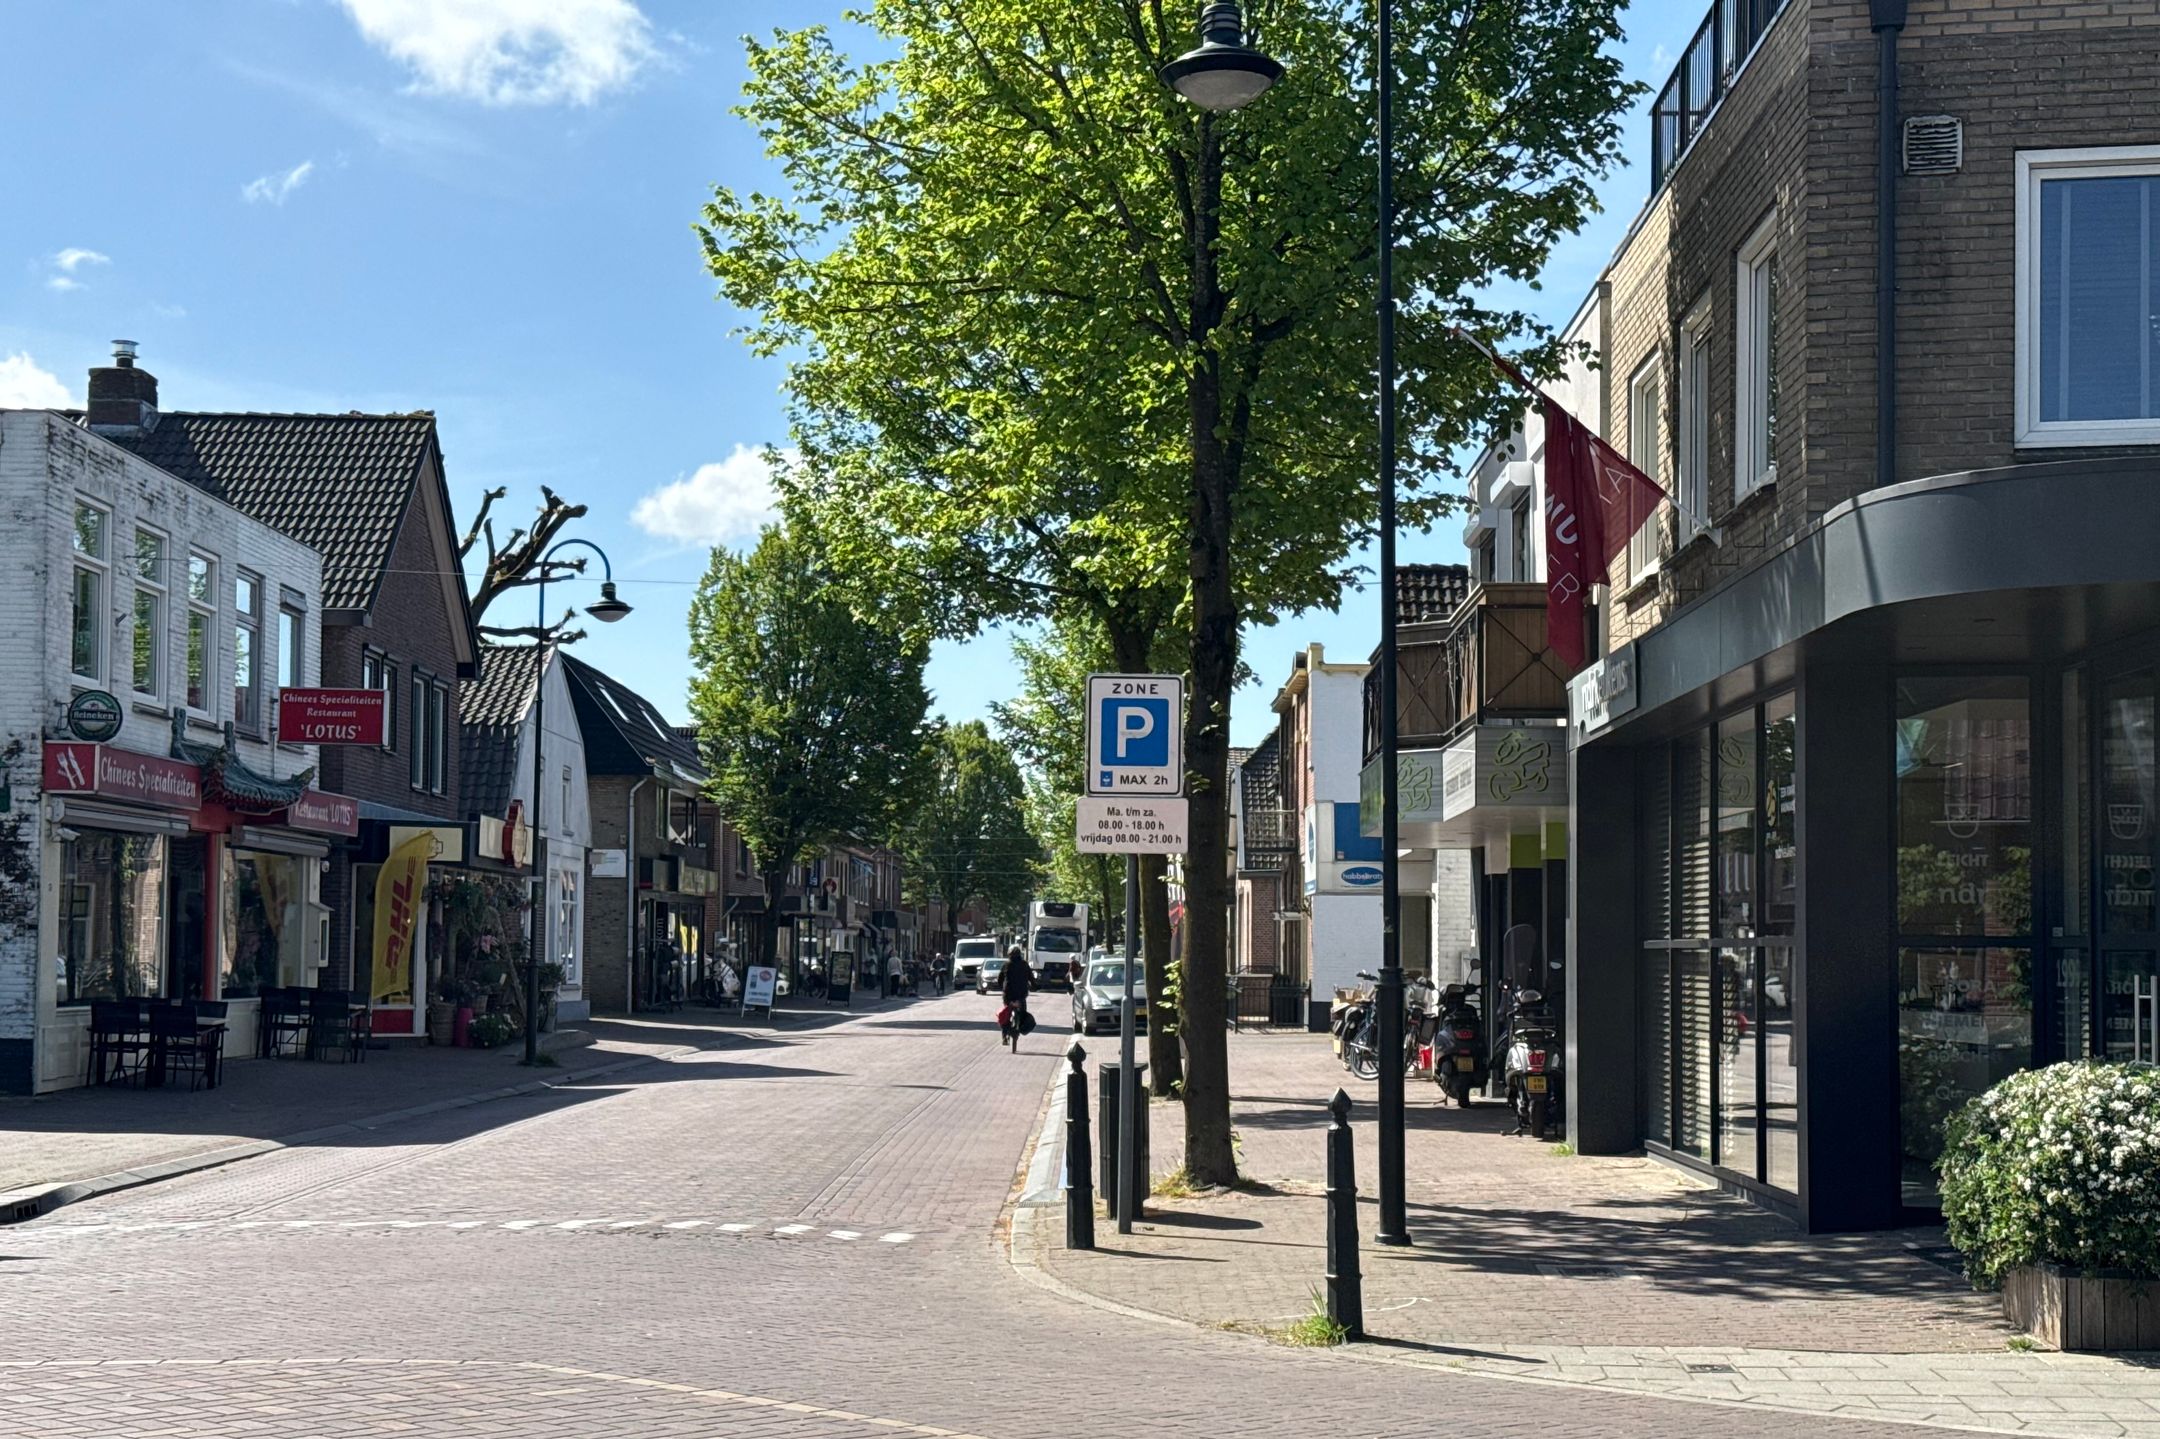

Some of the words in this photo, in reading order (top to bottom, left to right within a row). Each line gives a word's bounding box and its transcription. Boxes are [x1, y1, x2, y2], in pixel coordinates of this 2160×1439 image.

[1112, 683, 1159, 695] ZONE
[282, 693, 317, 704] Chinees
[320, 695, 382, 706] Specialiteiten
[73, 710, 115, 721] Heineken
[306, 707, 357, 718] Restaurant
[1117, 707, 1154, 758] P
[101, 756, 136, 788] Chinees
[139, 764, 196, 798] Specialiteiten
[1120, 774, 1147, 785] MAX
[1153, 775, 1169, 786] 2h
[1106, 806, 1123, 817] Ma.
[1125, 806, 1140, 817] t/m
[1143, 809, 1157, 818] za.
[1098, 820, 1123, 830] 08.00
[1132, 820, 1156, 830] 18.00
[1158, 821, 1165, 831] h
[1081, 832, 1113, 845] vrijdag
[1115, 833, 1140, 843] 08.00
[1148, 834, 1173, 844] 21.00
[1175, 835, 1182, 844] h
[386, 875, 414, 969] DHL
